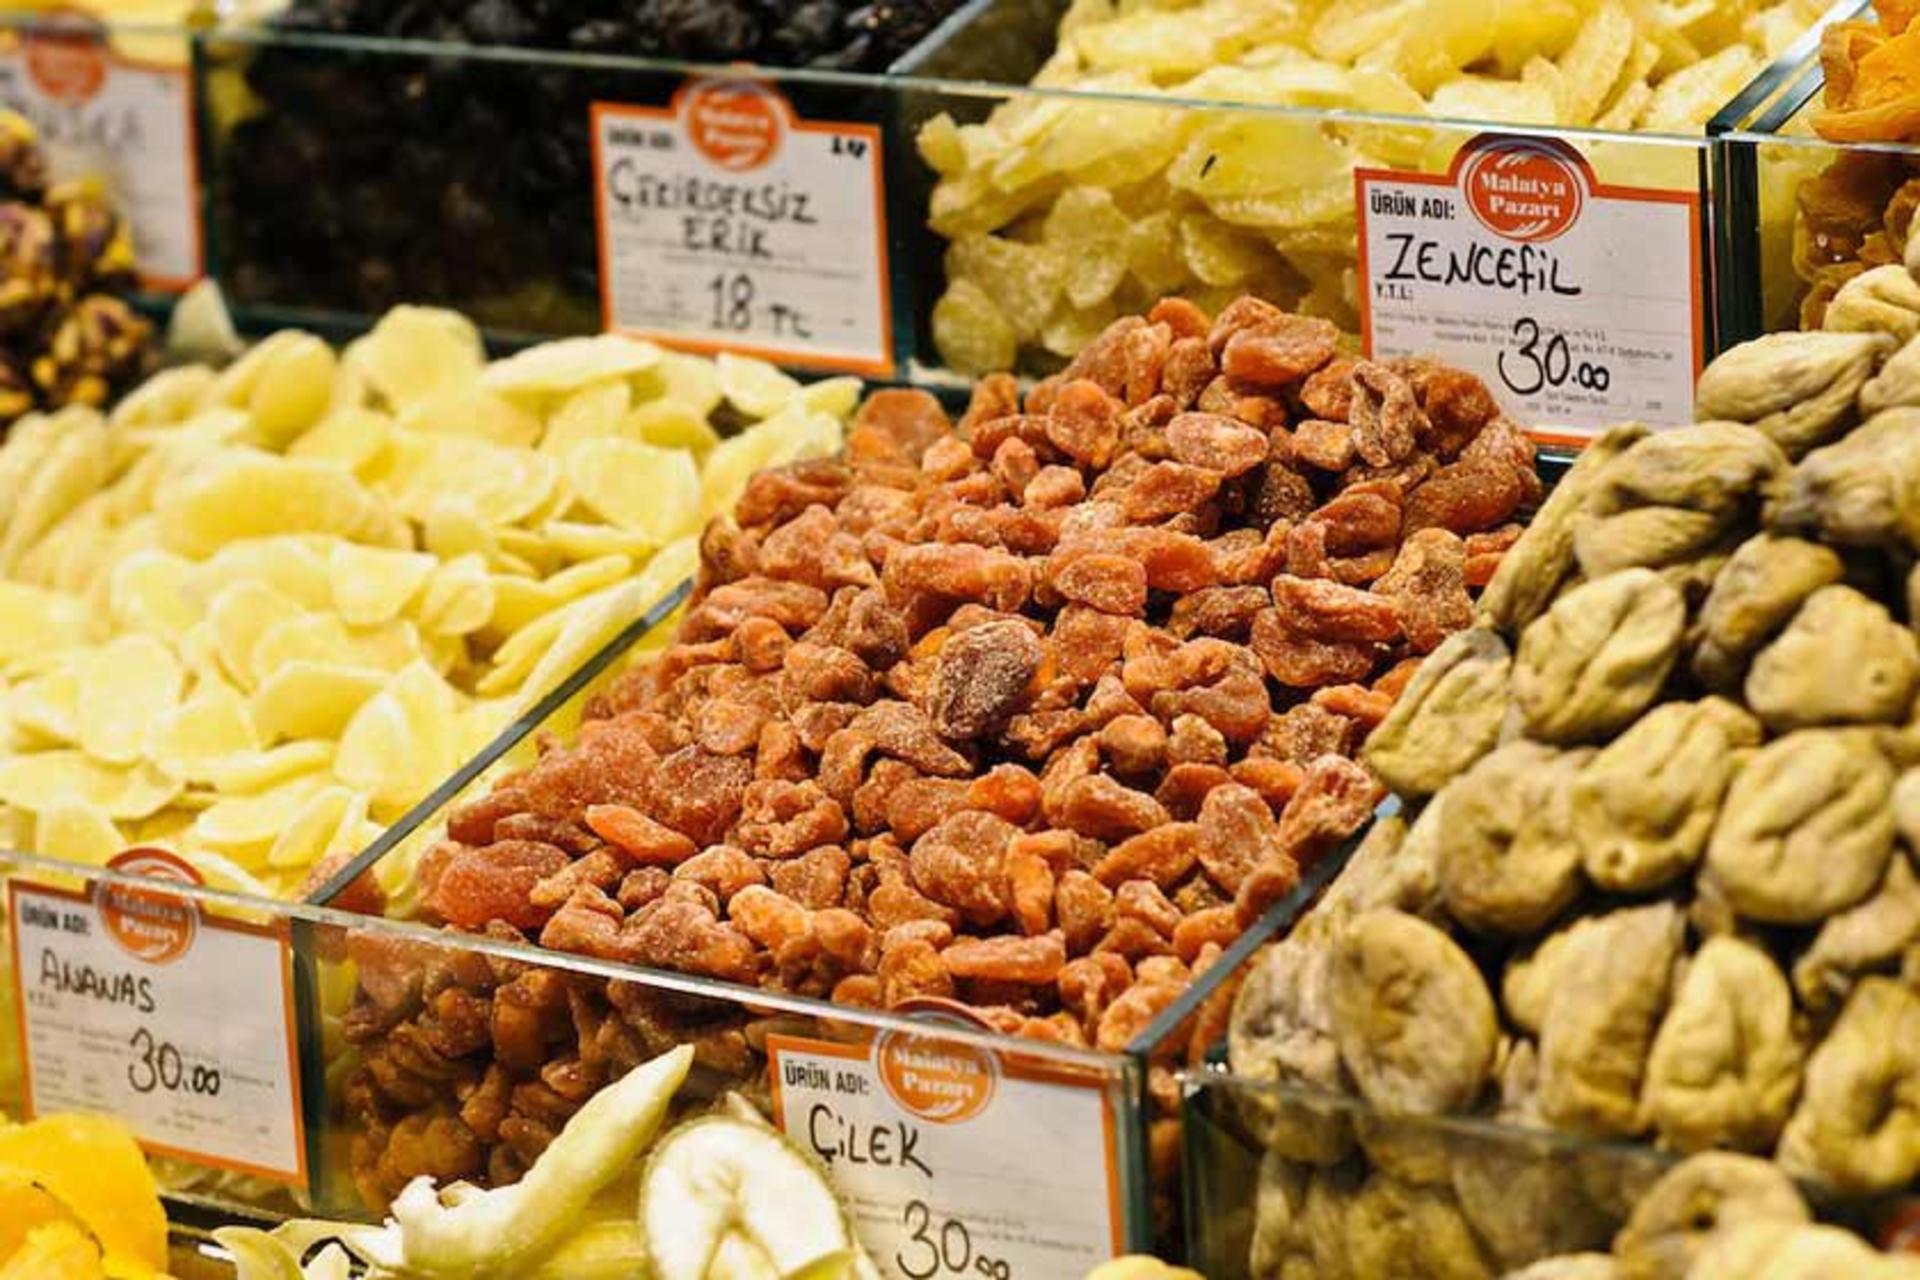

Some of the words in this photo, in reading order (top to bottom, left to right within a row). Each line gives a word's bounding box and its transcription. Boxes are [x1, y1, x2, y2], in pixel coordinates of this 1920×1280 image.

[1370, 188, 1416, 217] ÜRÜN
[1481, 171, 1567, 200] Malatya
[709, 274, 754, 331] 18
[1497, 317, 1611, 395] 30.00
[40, 948, 155, 1013] ANANAS
[785, 1059, 830, 1092] ÜRÜN
